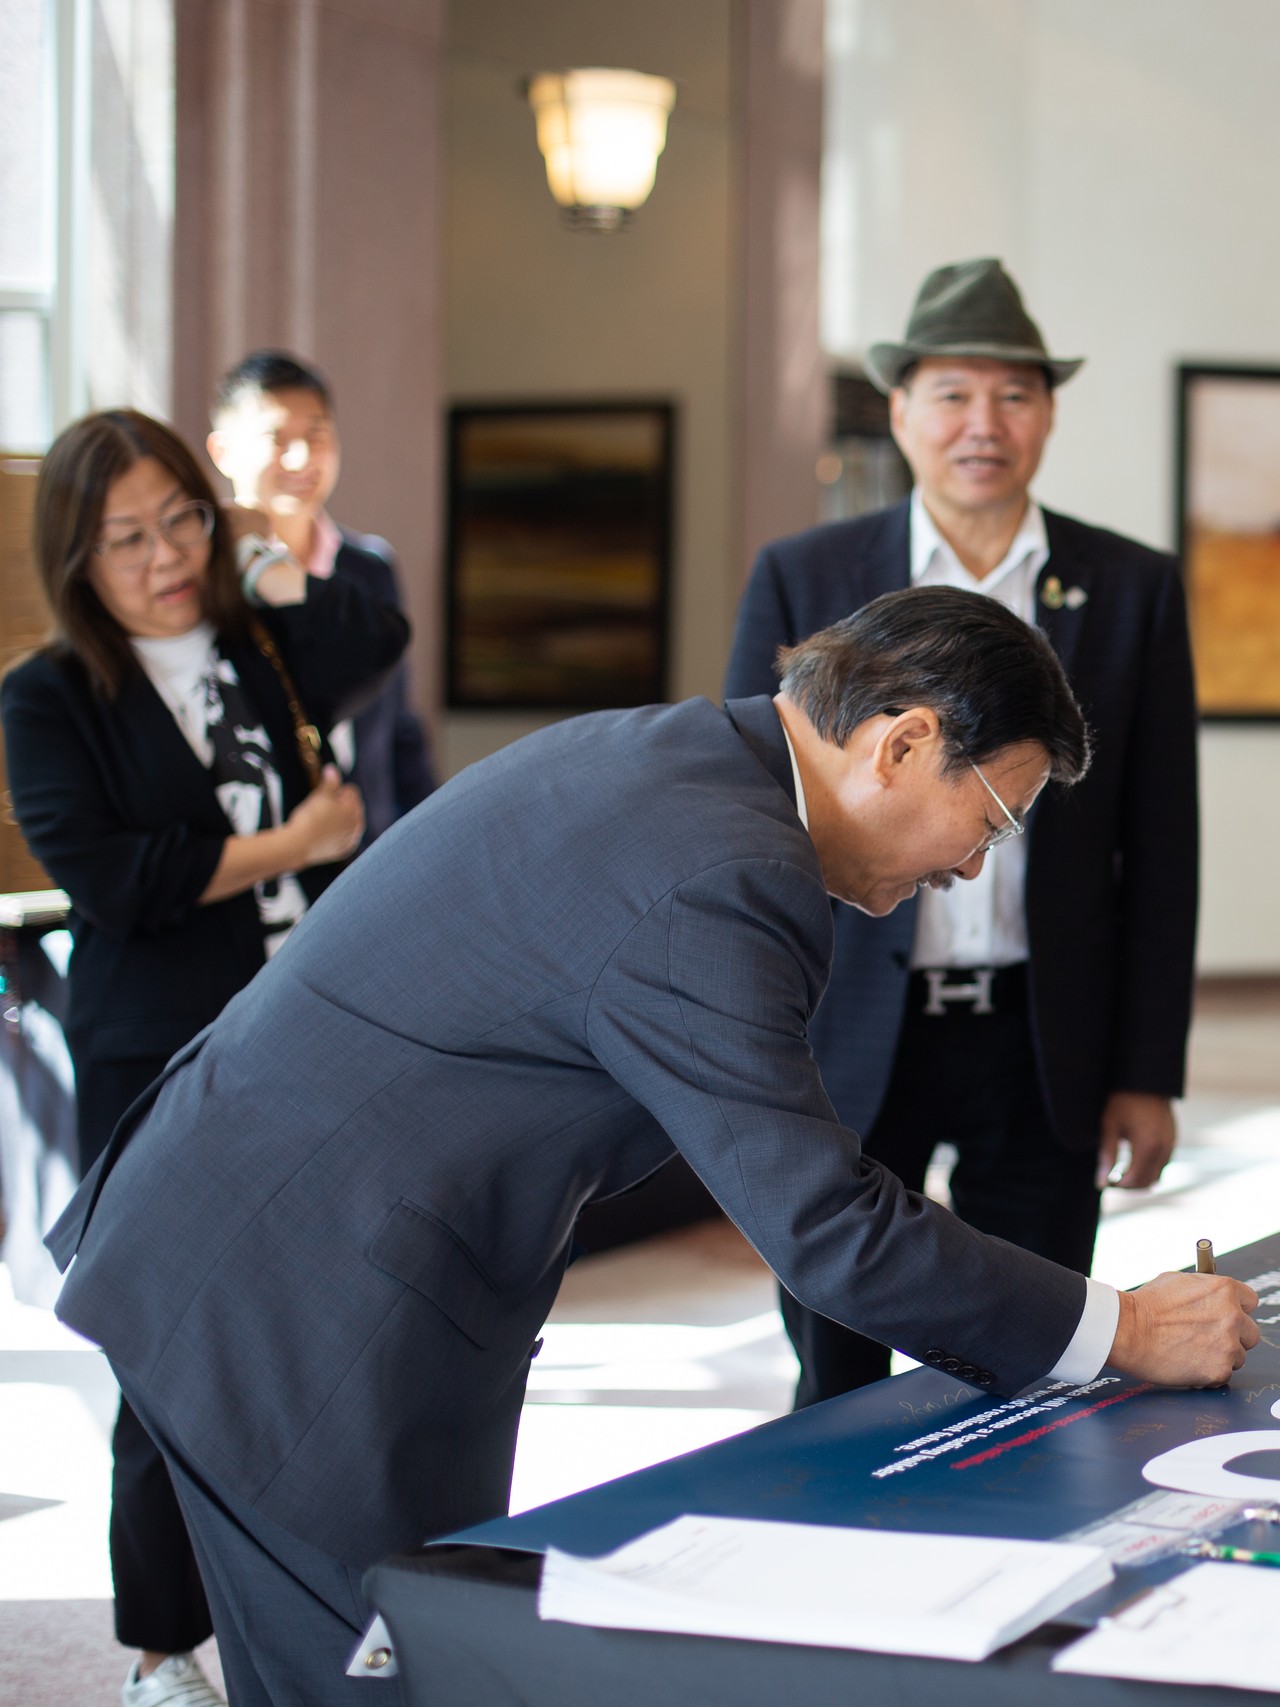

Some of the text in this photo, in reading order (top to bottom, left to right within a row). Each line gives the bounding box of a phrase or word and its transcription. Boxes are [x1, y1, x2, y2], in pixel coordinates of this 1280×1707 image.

[1065, 1377, 1121, 1397] Canada
[1040, 1396, 1072, 1408] will
[941, 1407, 1006, 1433] resilient
[988, 1406, 1053, 1429] become
[893, 1431, 954, 1452] future.
[919, 1433, 988, 1456] leading
[871, 1452, 935, 1478] builder
